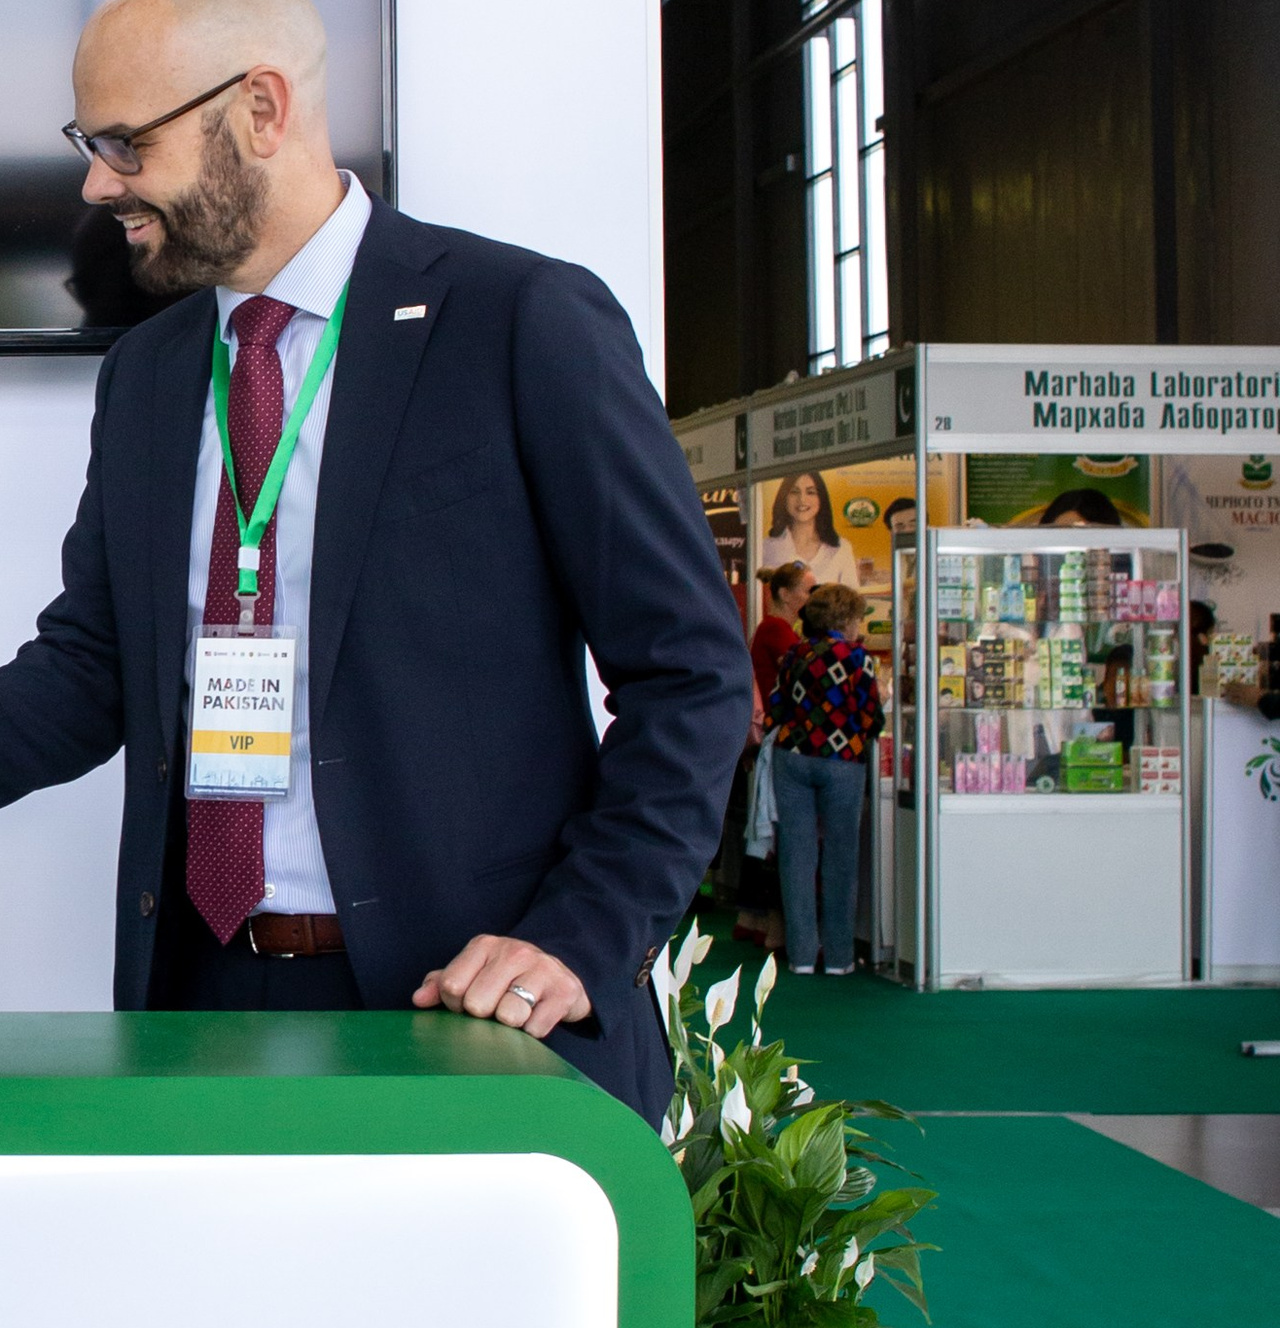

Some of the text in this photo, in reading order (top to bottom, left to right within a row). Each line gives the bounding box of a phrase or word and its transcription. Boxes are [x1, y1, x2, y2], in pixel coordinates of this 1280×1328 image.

[1024, 370, 1280, 398] Marhaba Laboratori
[1033, 401, 1280, 435] Мархаба Лаборато
[207, 677, 280, 693] MADE IN
[203, 695, 285, 711] PAKISTAN
[230, 735, 254, 750] VIP
